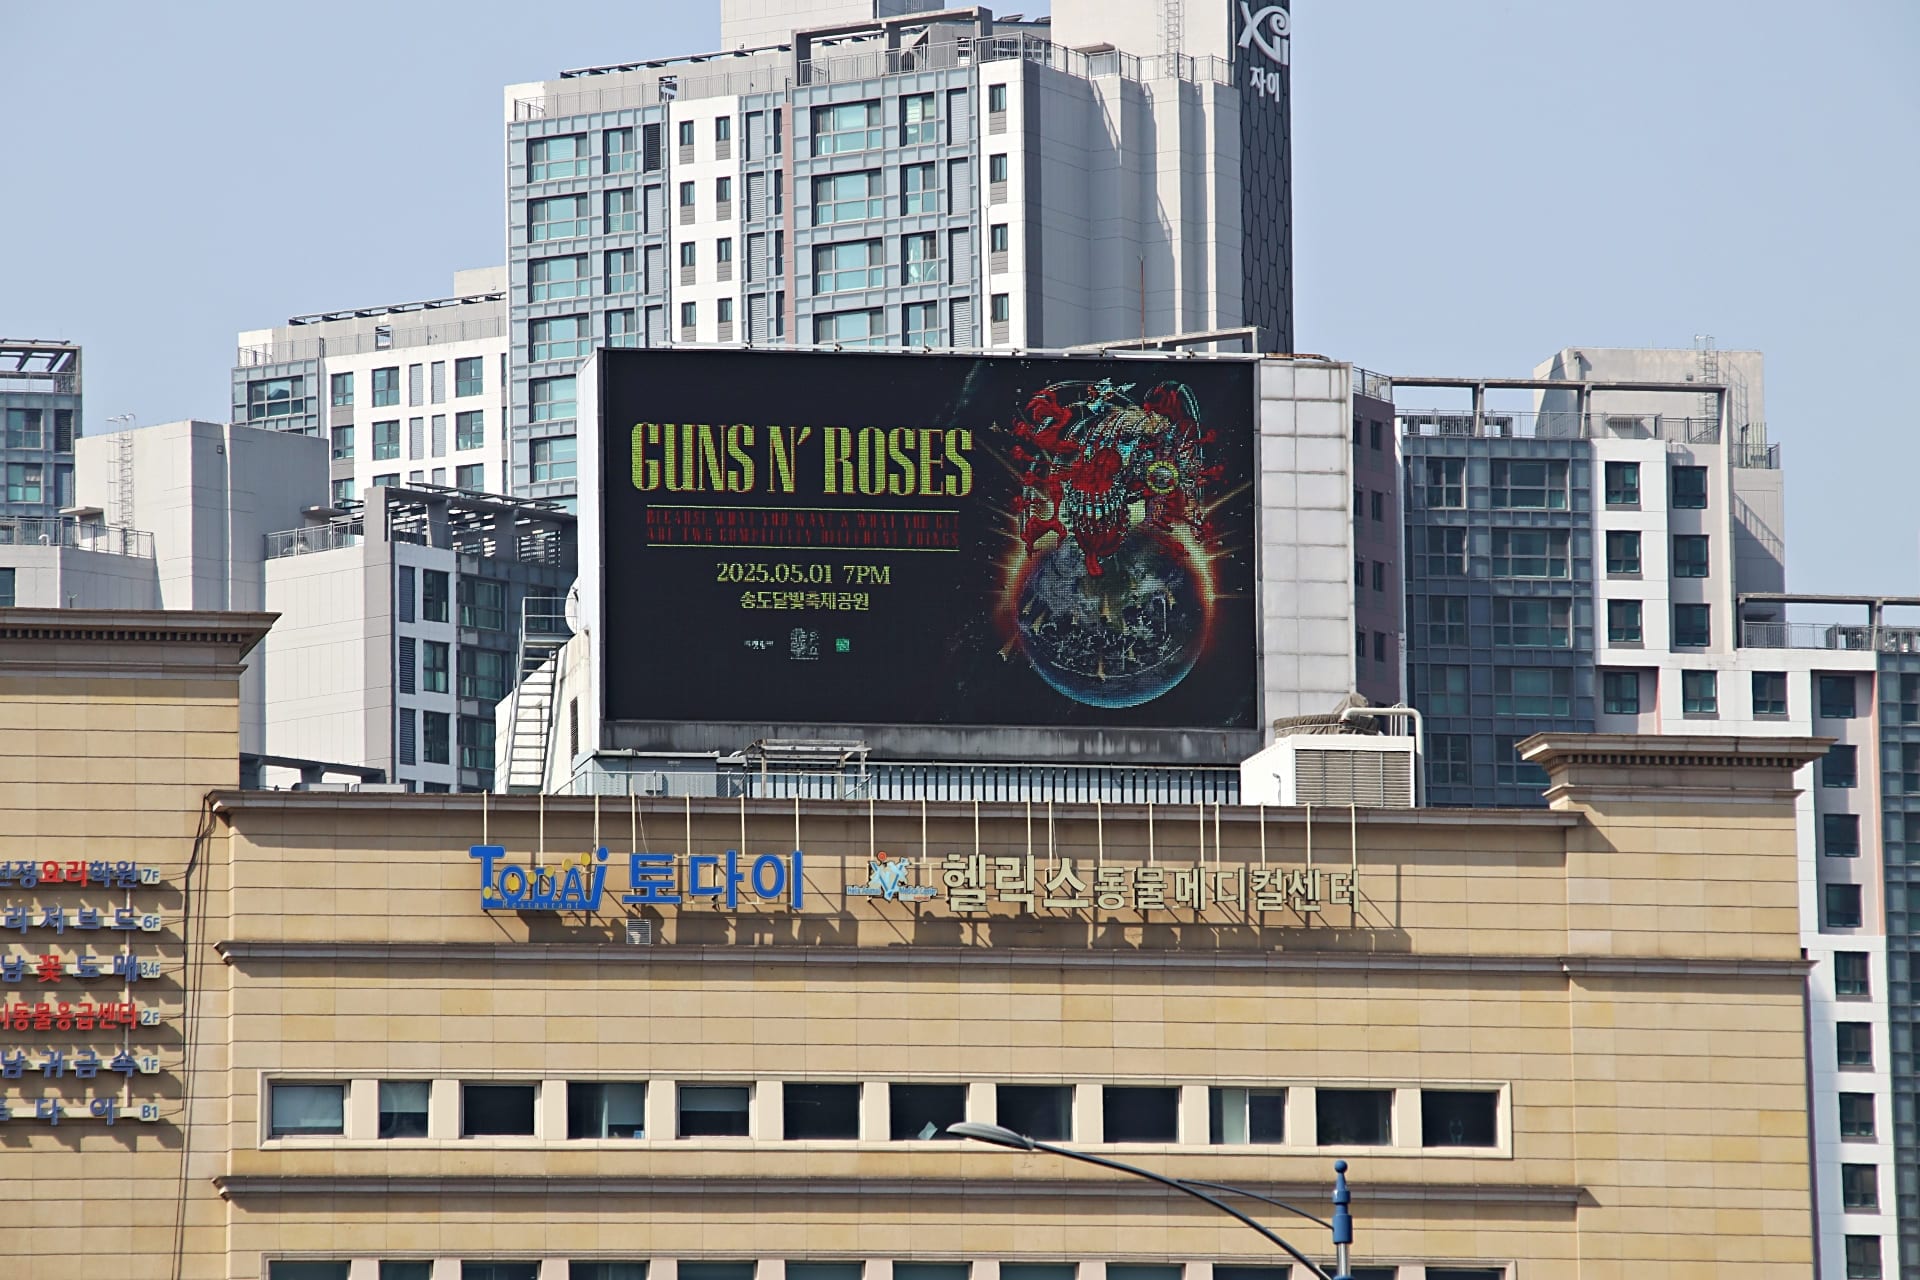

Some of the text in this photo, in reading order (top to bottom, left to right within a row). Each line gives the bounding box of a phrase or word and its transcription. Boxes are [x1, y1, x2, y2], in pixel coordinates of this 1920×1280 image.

[1249, 66, 1280, 102] 자이
[631, 422, 755, 492] GUNS
[822, 426, 973, 496] ROSES
[716, 563, 892, 585] 2025.05.01 7PM
[740, 591, 870, 610] 송도달빛축제공원
[143, 868, 160, 882] 7F
[622, 849, 803, 910] 토다이
[143, 915, 160, 929] 6F
[142, 1010, 159, 1024] 2F
[143, 1057, 158, 1070] 1F
[142, 1105, 158, 1119] B1
